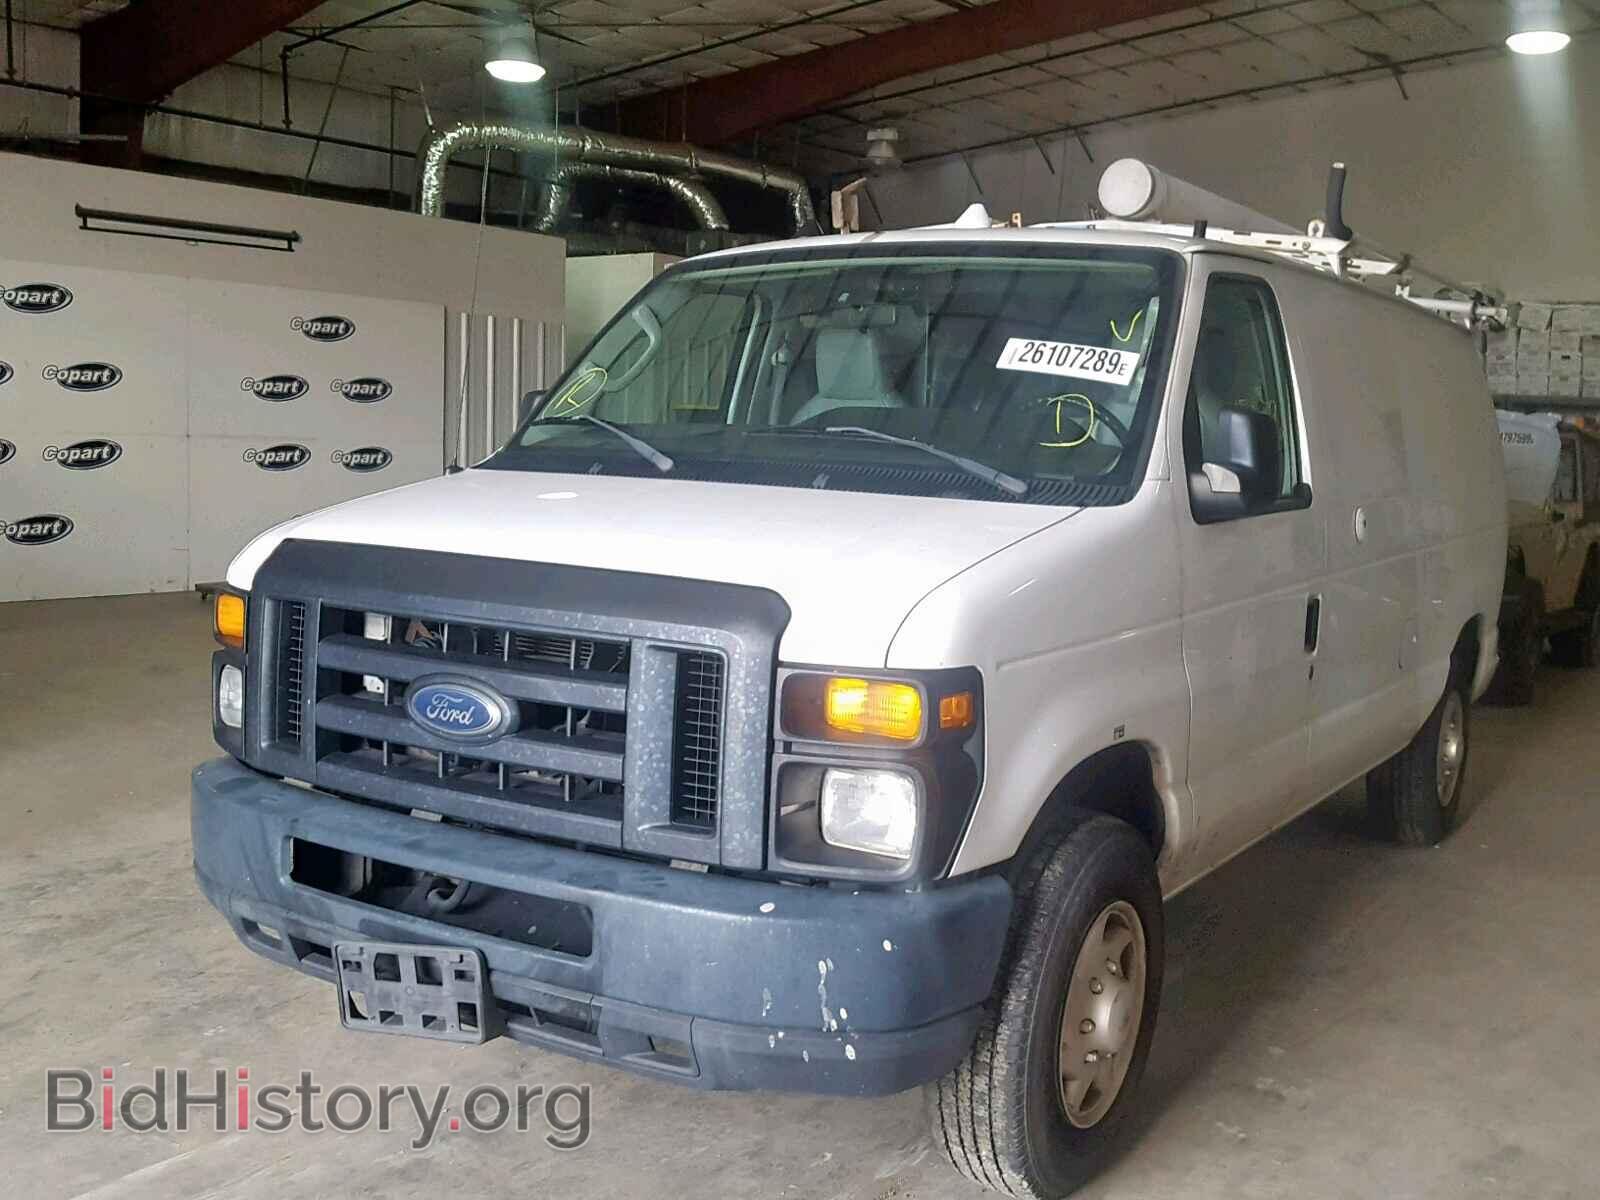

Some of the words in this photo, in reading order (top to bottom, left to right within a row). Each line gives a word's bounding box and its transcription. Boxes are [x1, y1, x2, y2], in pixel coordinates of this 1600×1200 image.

[290, 317, 346, 334] Copart
[42, 364, 111, 384] Copart
[241, 377, 299, 396] Copart
[330, 379, 384, 396] Copart
[42, 445, 111, 464] Copart
[243, 447, 302, 465] Copart
[331, 449, 385, 466] Copart
[426, 693, 476, 725] Ford
